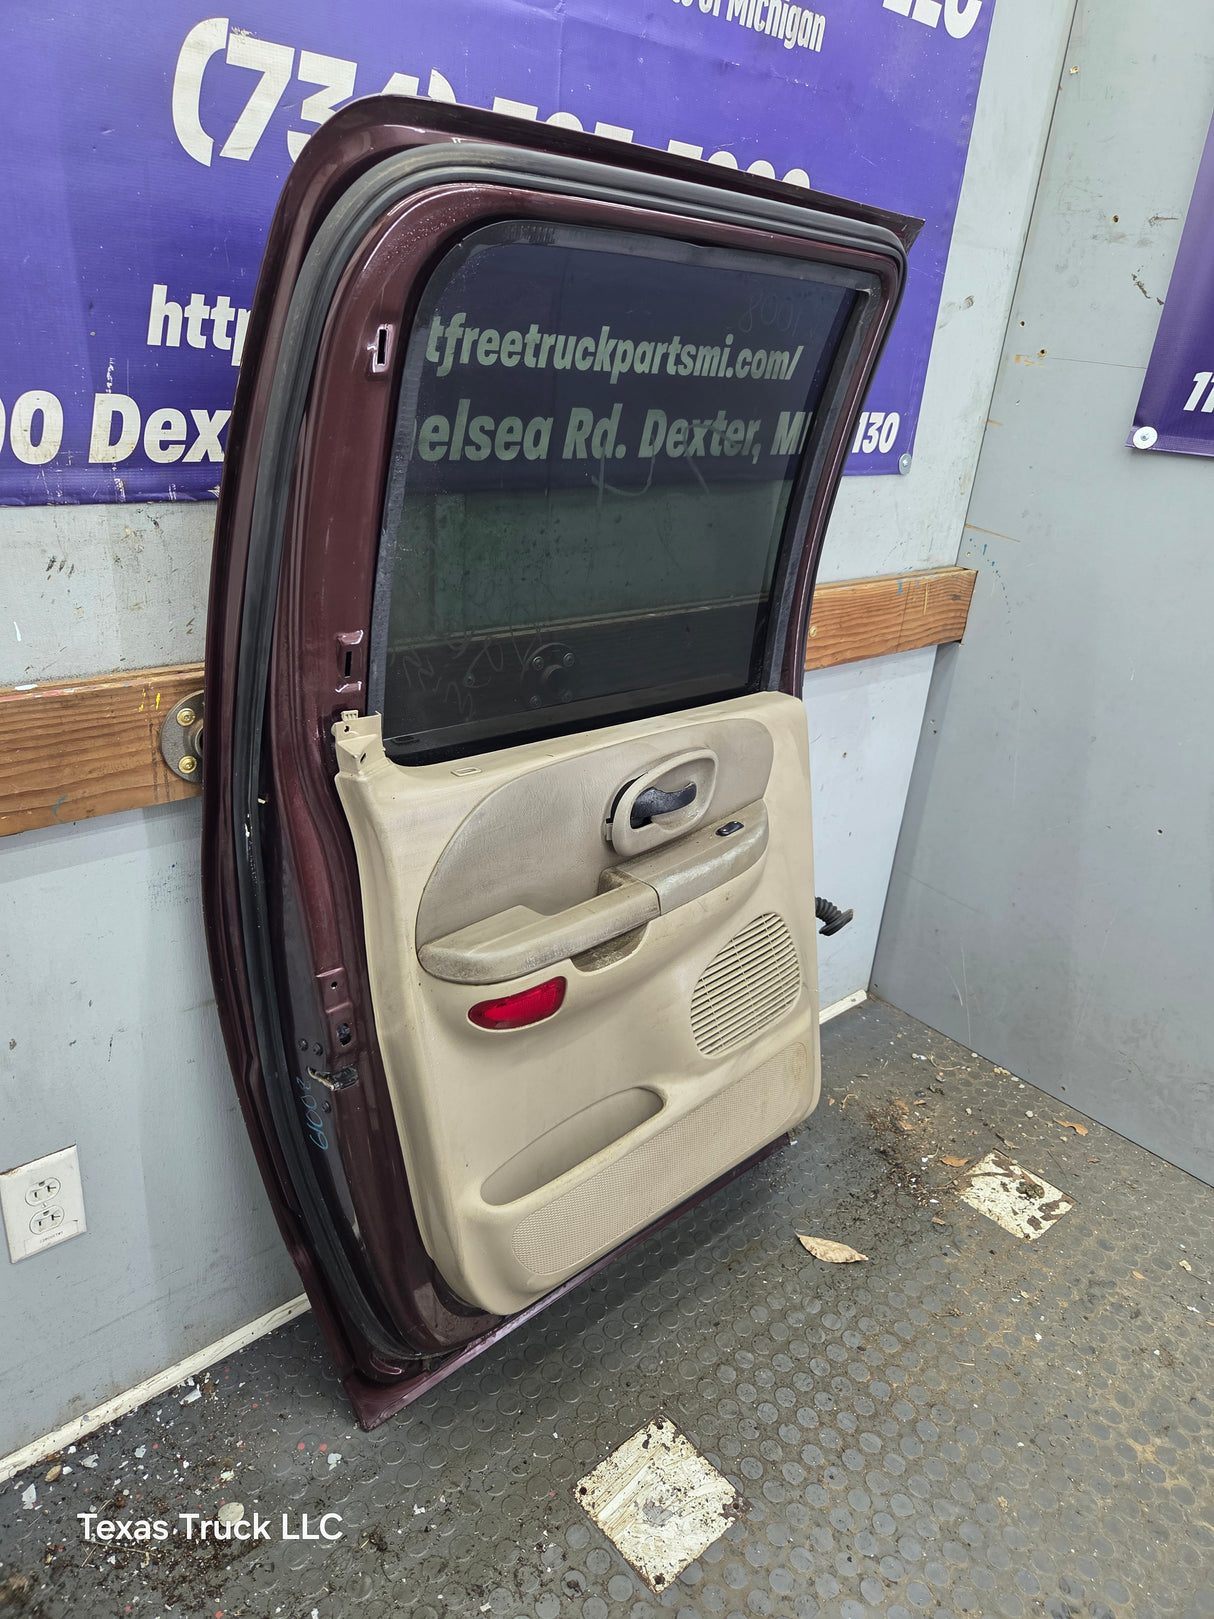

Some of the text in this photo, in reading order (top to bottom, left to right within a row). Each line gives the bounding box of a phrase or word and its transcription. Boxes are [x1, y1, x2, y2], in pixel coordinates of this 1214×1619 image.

[0, 390, 64, 465] 0
[409, 399, 554, 462] elsea
[562, 403, 627, 459] Rd.
[638, 409, 762, 465] Dexter,
